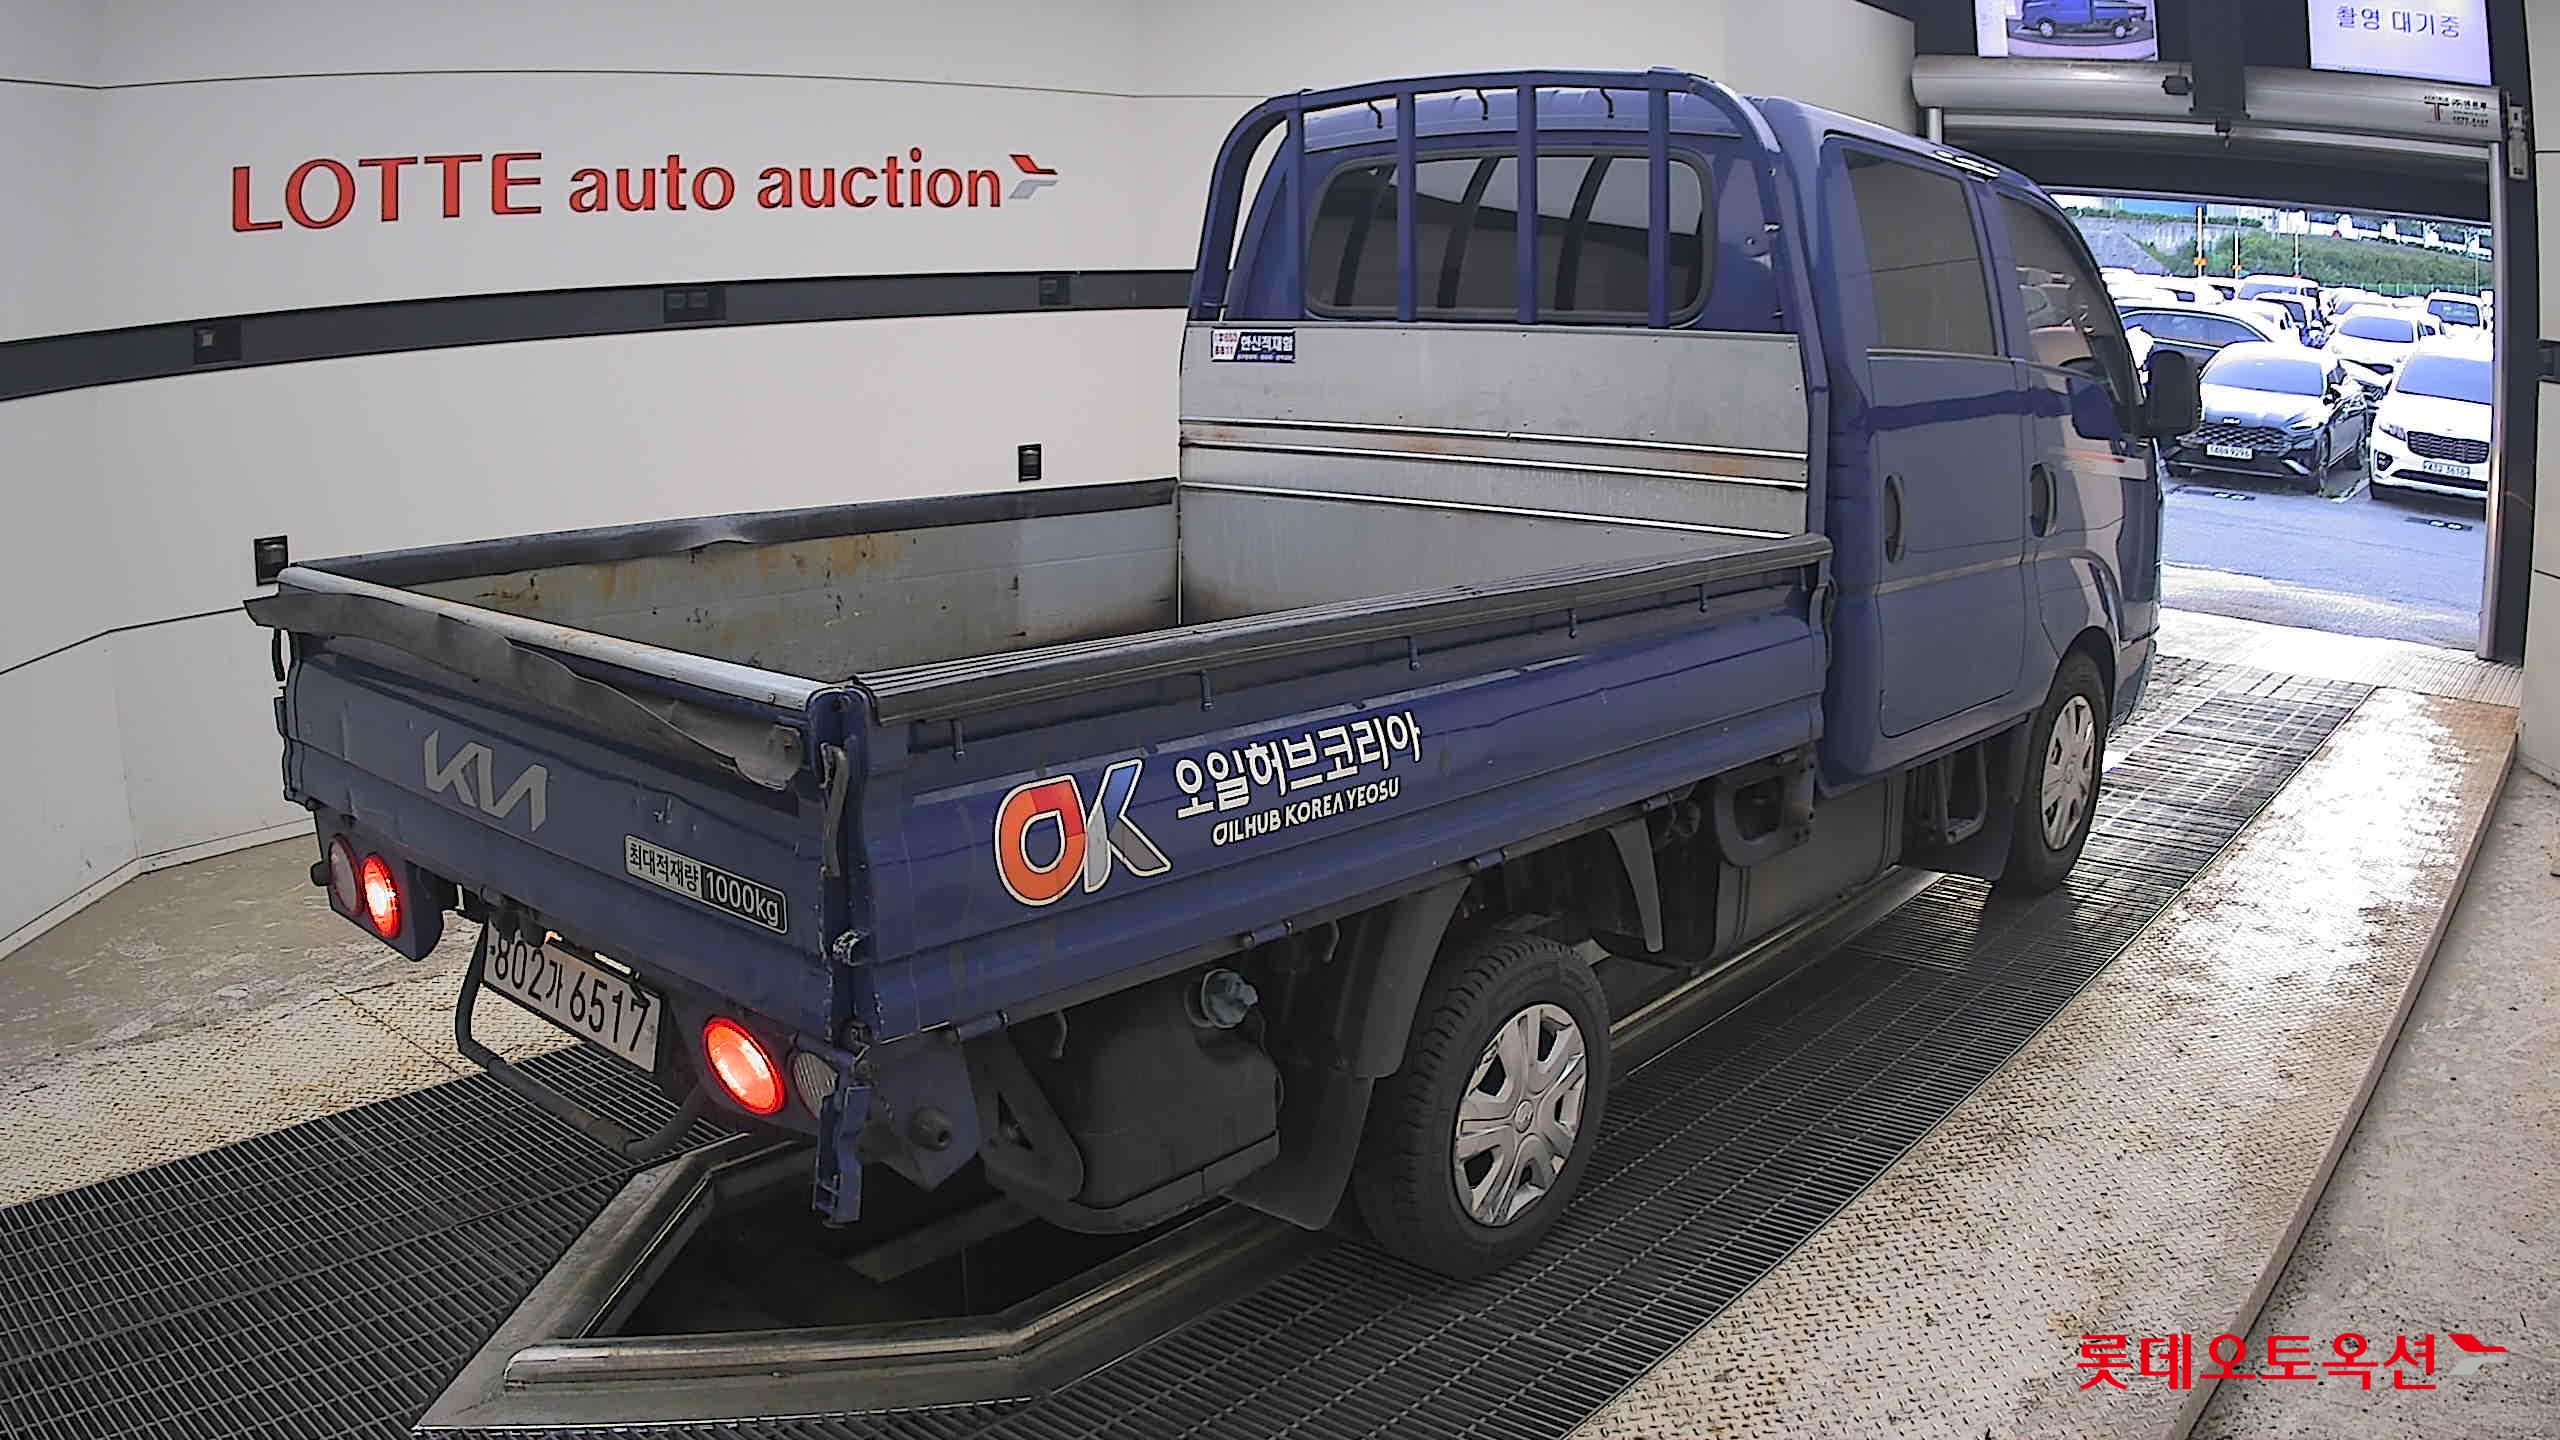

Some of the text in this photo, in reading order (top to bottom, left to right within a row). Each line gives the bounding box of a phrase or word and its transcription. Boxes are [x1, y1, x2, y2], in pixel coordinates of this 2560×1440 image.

[2391, 10, 2460, 38] 대기중
[232, 147, 1001, 232] LOTTE auto auction
[424, 729, 548, 832] KIA
[1176, 711, 1421, 819] 오일허브코리아
[994, 758, 1172, 907] OK
[1212, 777, 1400, 846] OILHUB KOREA YEOSU
[630, 842, 779, 927] 최대적재량 1000kg
